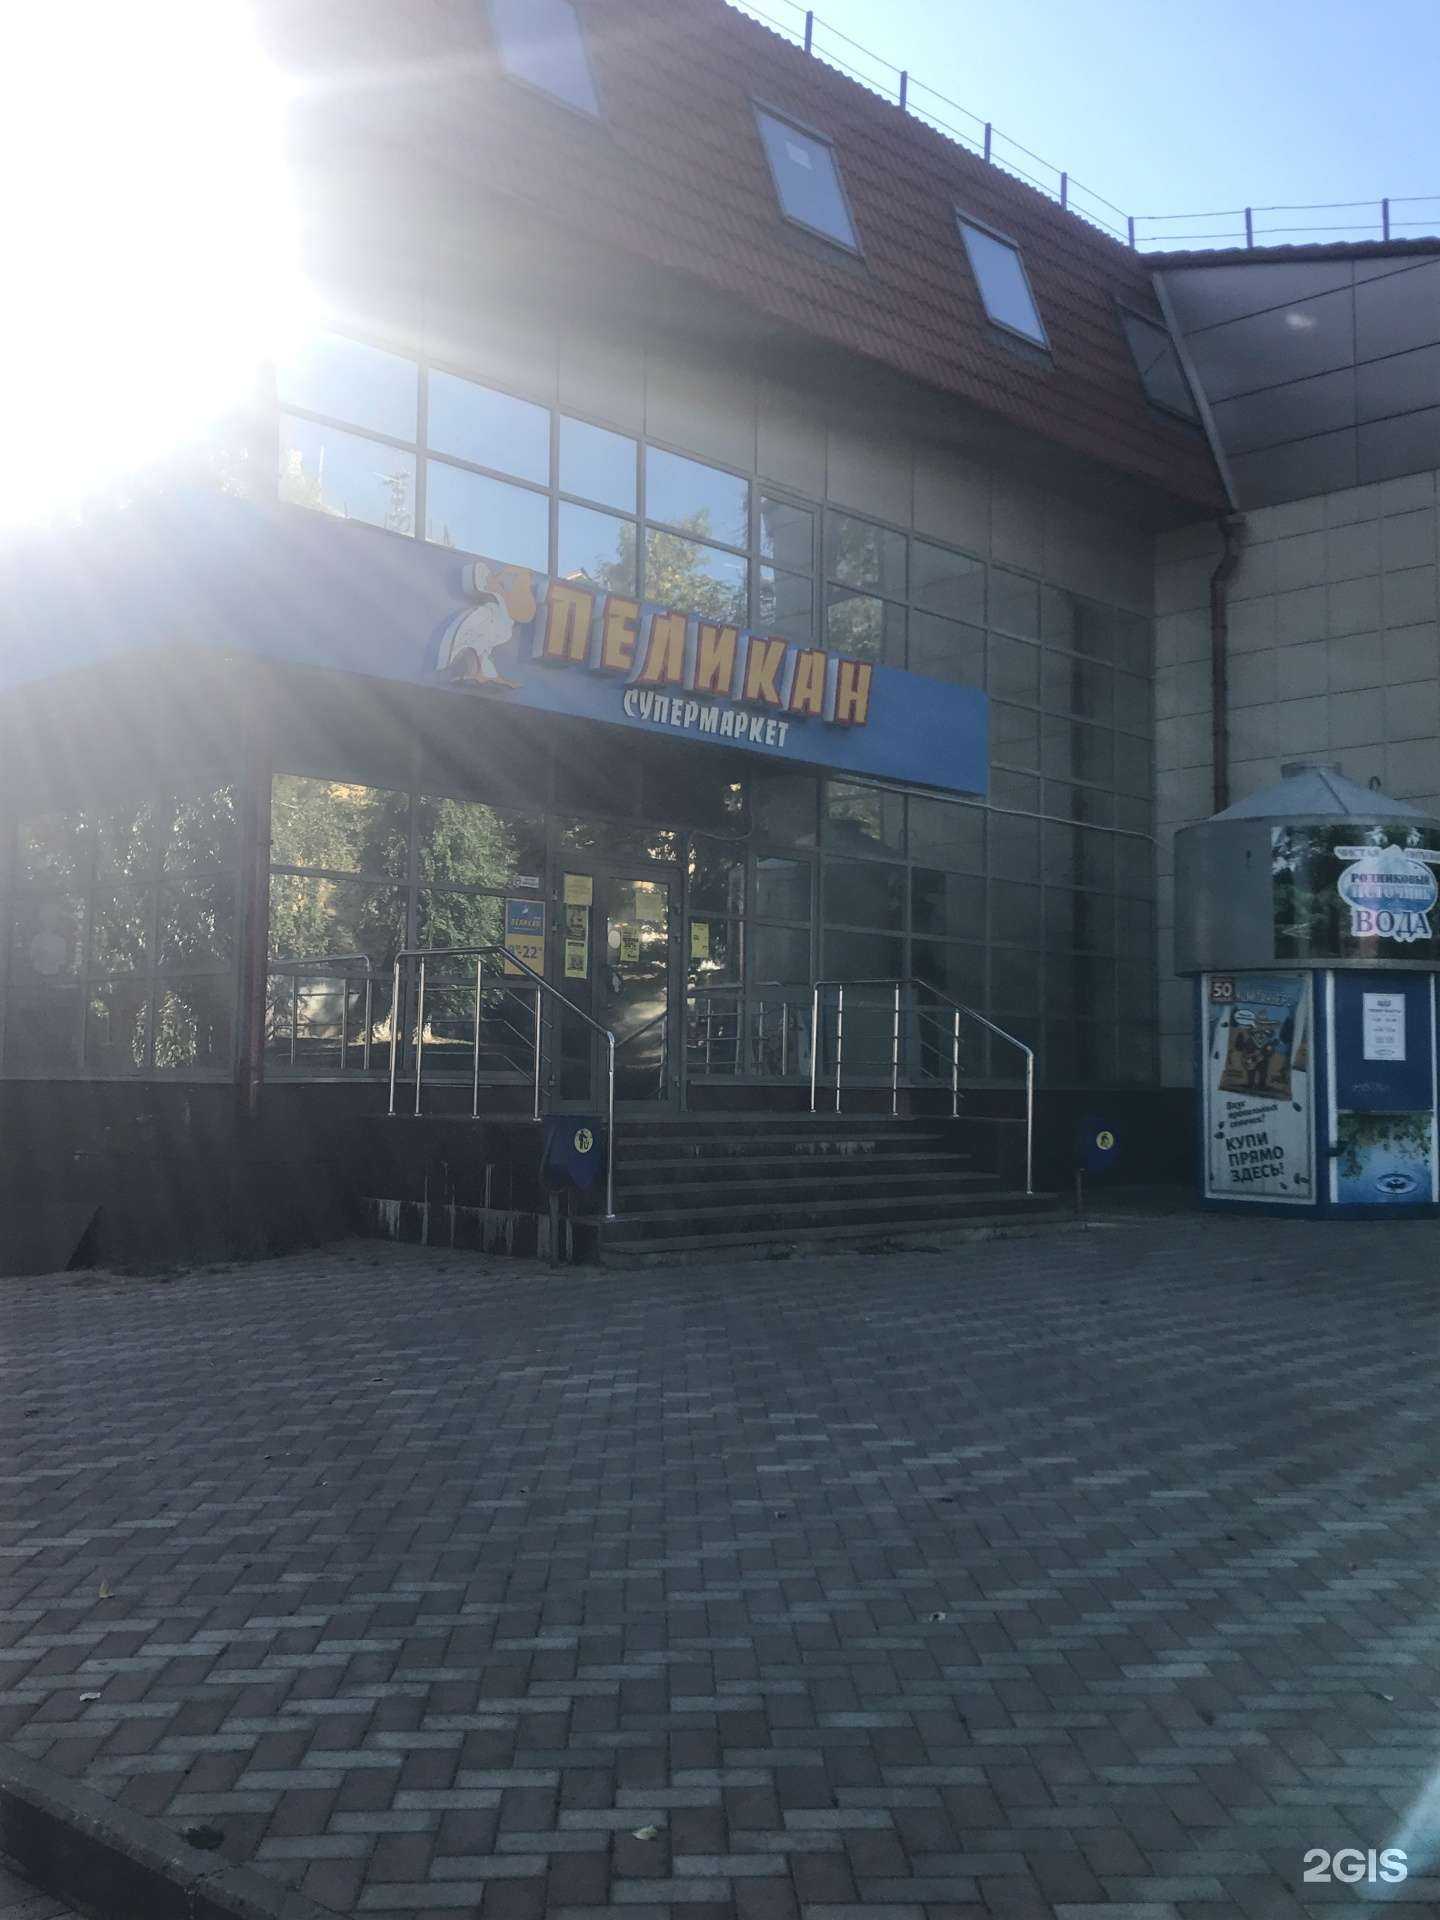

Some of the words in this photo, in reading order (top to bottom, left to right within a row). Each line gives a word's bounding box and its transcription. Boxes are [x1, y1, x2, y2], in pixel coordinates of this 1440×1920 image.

[540, 580, 873, 725] ПЕЛИКАН
[622, 690, 789, 747] СУПЕРМАРКЕТ
[1355, 910, 1429, 937] ВОДА
[1213, 982, 1232, 997] 50
[1226, 1132, 1268, 1151] КУПИ
[1228, 1146, 1284, 1167] ПРЯМО
[1231, 1162, 1284, 1183] ЗДЕСЬ!
